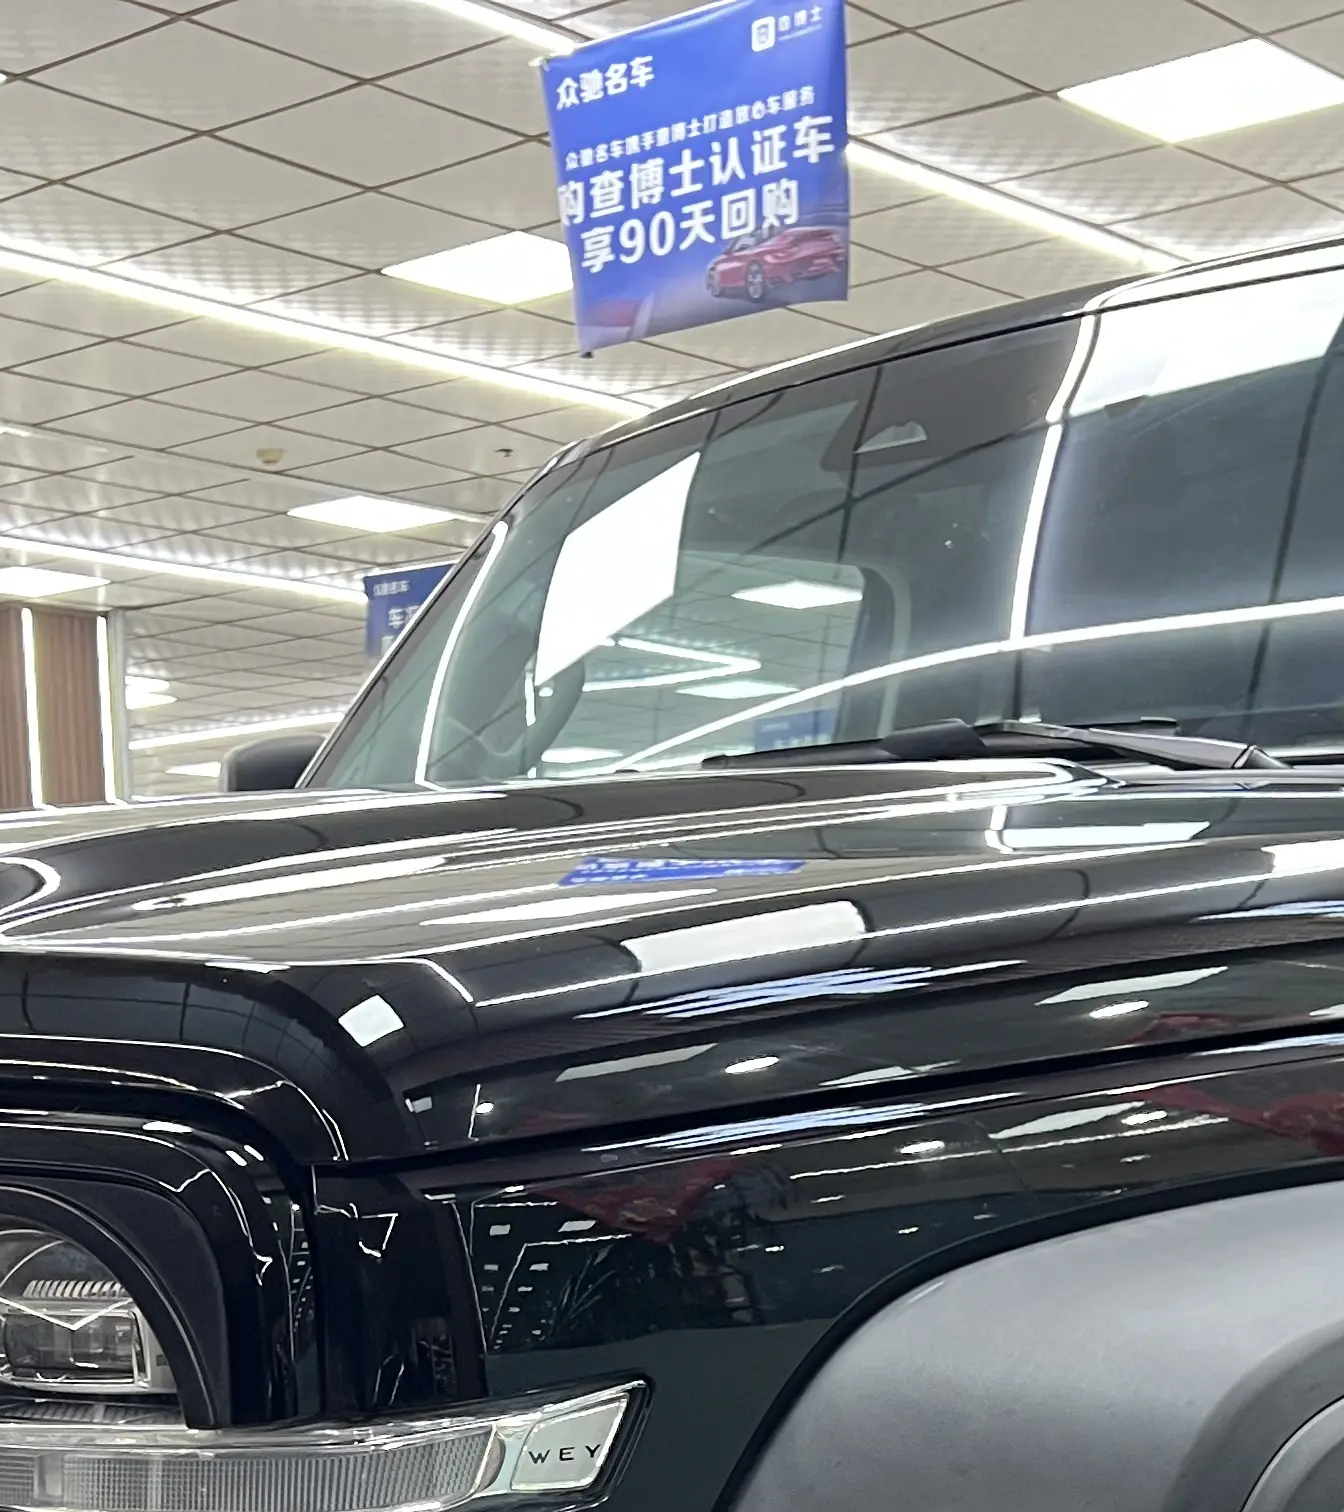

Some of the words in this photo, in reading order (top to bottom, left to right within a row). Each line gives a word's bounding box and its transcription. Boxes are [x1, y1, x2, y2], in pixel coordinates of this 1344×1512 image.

[555, 56, 655, 111] 众驰名车
[580, 178, 800, 275] 享90天回购
[528, 1443, 602, 1464] WEY
